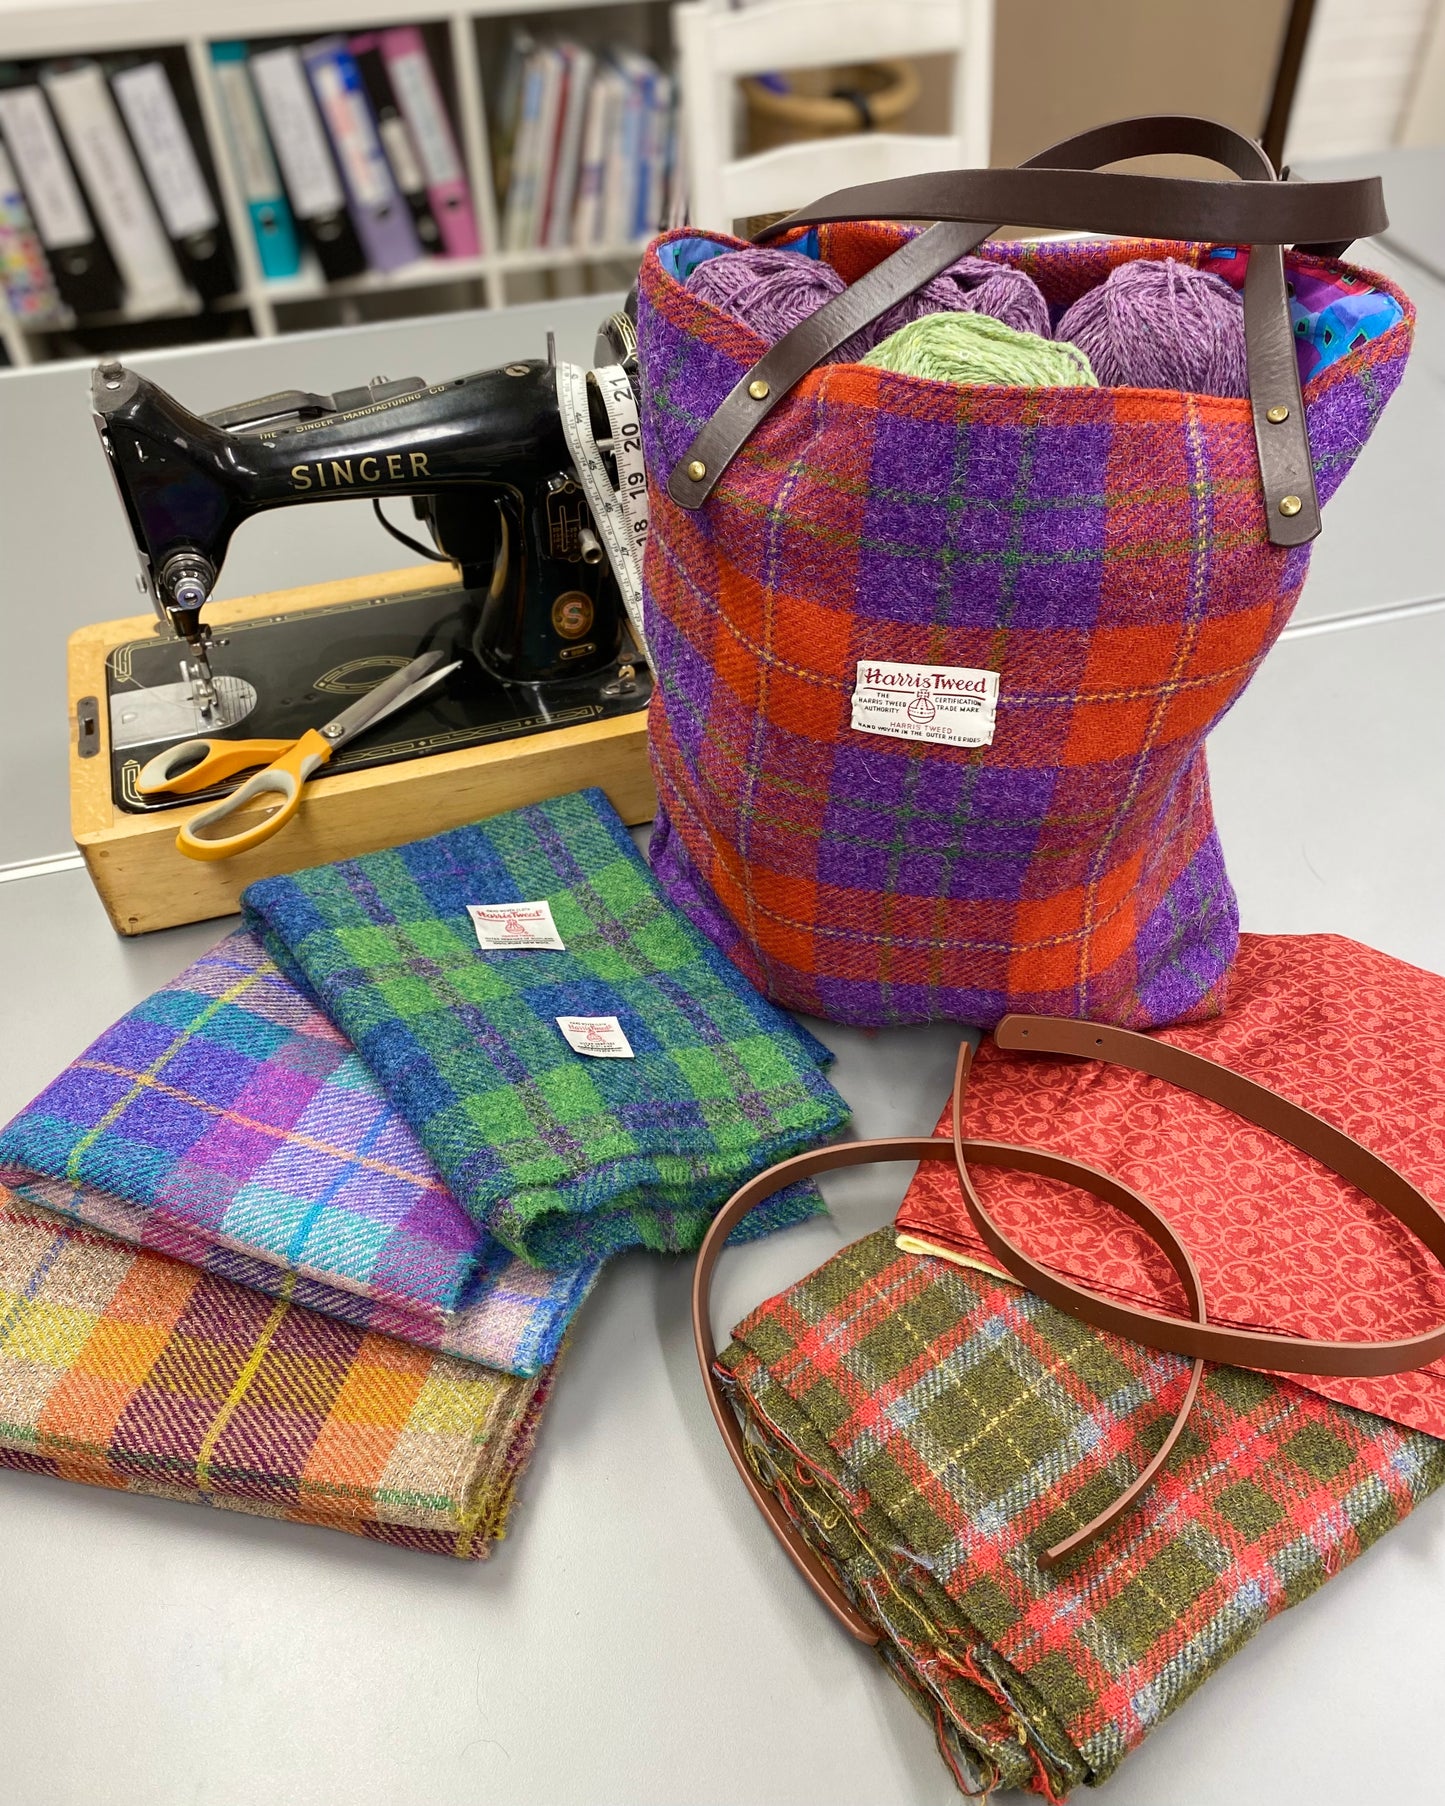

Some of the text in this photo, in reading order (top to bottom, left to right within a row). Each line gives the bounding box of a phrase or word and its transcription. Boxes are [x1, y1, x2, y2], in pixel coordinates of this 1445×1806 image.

[609, 377, 633, 402] 21
[295, 419, 334, 433] SINGER
[342, 393, 422, 421] MANUFACTURING
[622, 422, 640, 453] 20
[291, 452, 431, 490] SINGER
[588, 460, 598, 470] 45
[628, 472, 646, 500] 19
[604, 502, 614, 512] 46
[633, 519, 648, 546] 18
[620, 546, 630, 556] 47
[563, 602, 584, 629] S
[858, 697, 882, 705] HARRIS
[935, 697, 982, 706] CERTIFICATION
[937, 704, 957, 712] TRADE
[858, 722, 876, 730] HAND
[926, 732, 946, 740] OUTER
[890, 722, 952, 734] HARRIS TWEED
